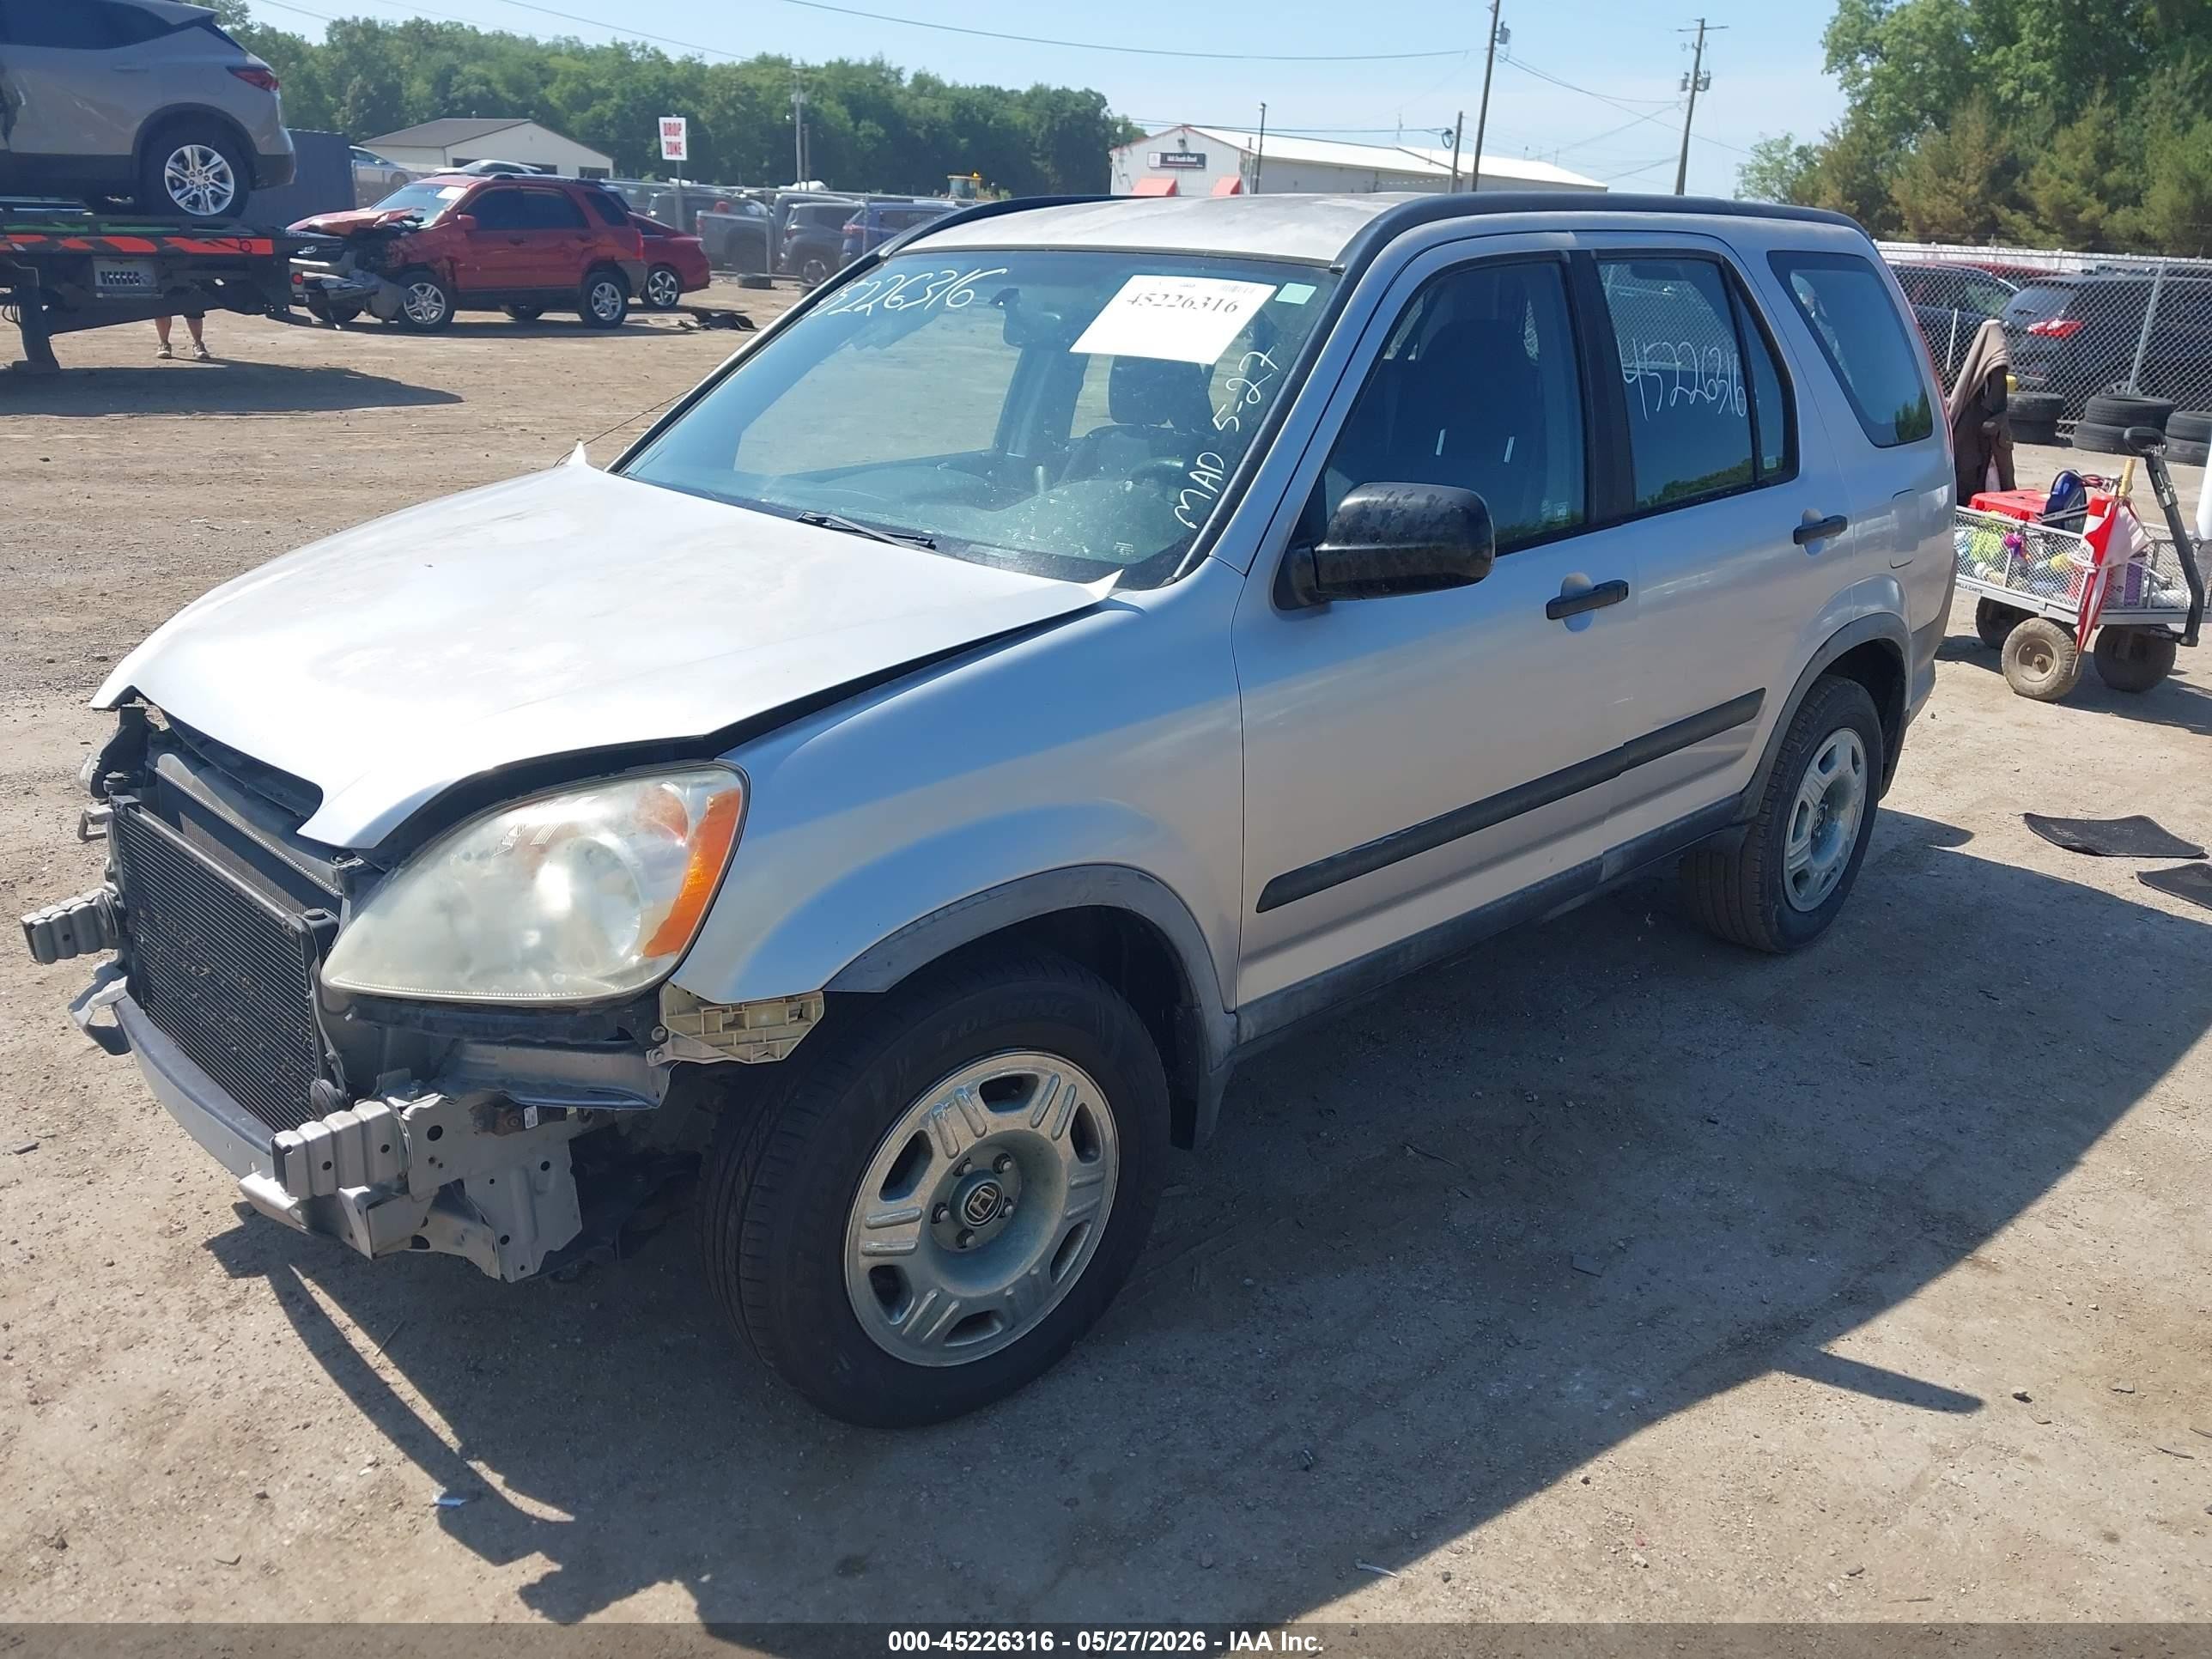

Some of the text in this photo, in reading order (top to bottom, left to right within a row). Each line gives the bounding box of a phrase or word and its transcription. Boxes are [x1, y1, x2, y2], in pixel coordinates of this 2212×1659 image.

[663, 122, 682, 137] DROP
[665, 141, 683, 155] ZONE
[1126, 292, 1239, 314] 45226316
[1616, 335, 1747, 421] 45226316
[1174, 345, 1279, 529] MAD 5-27
